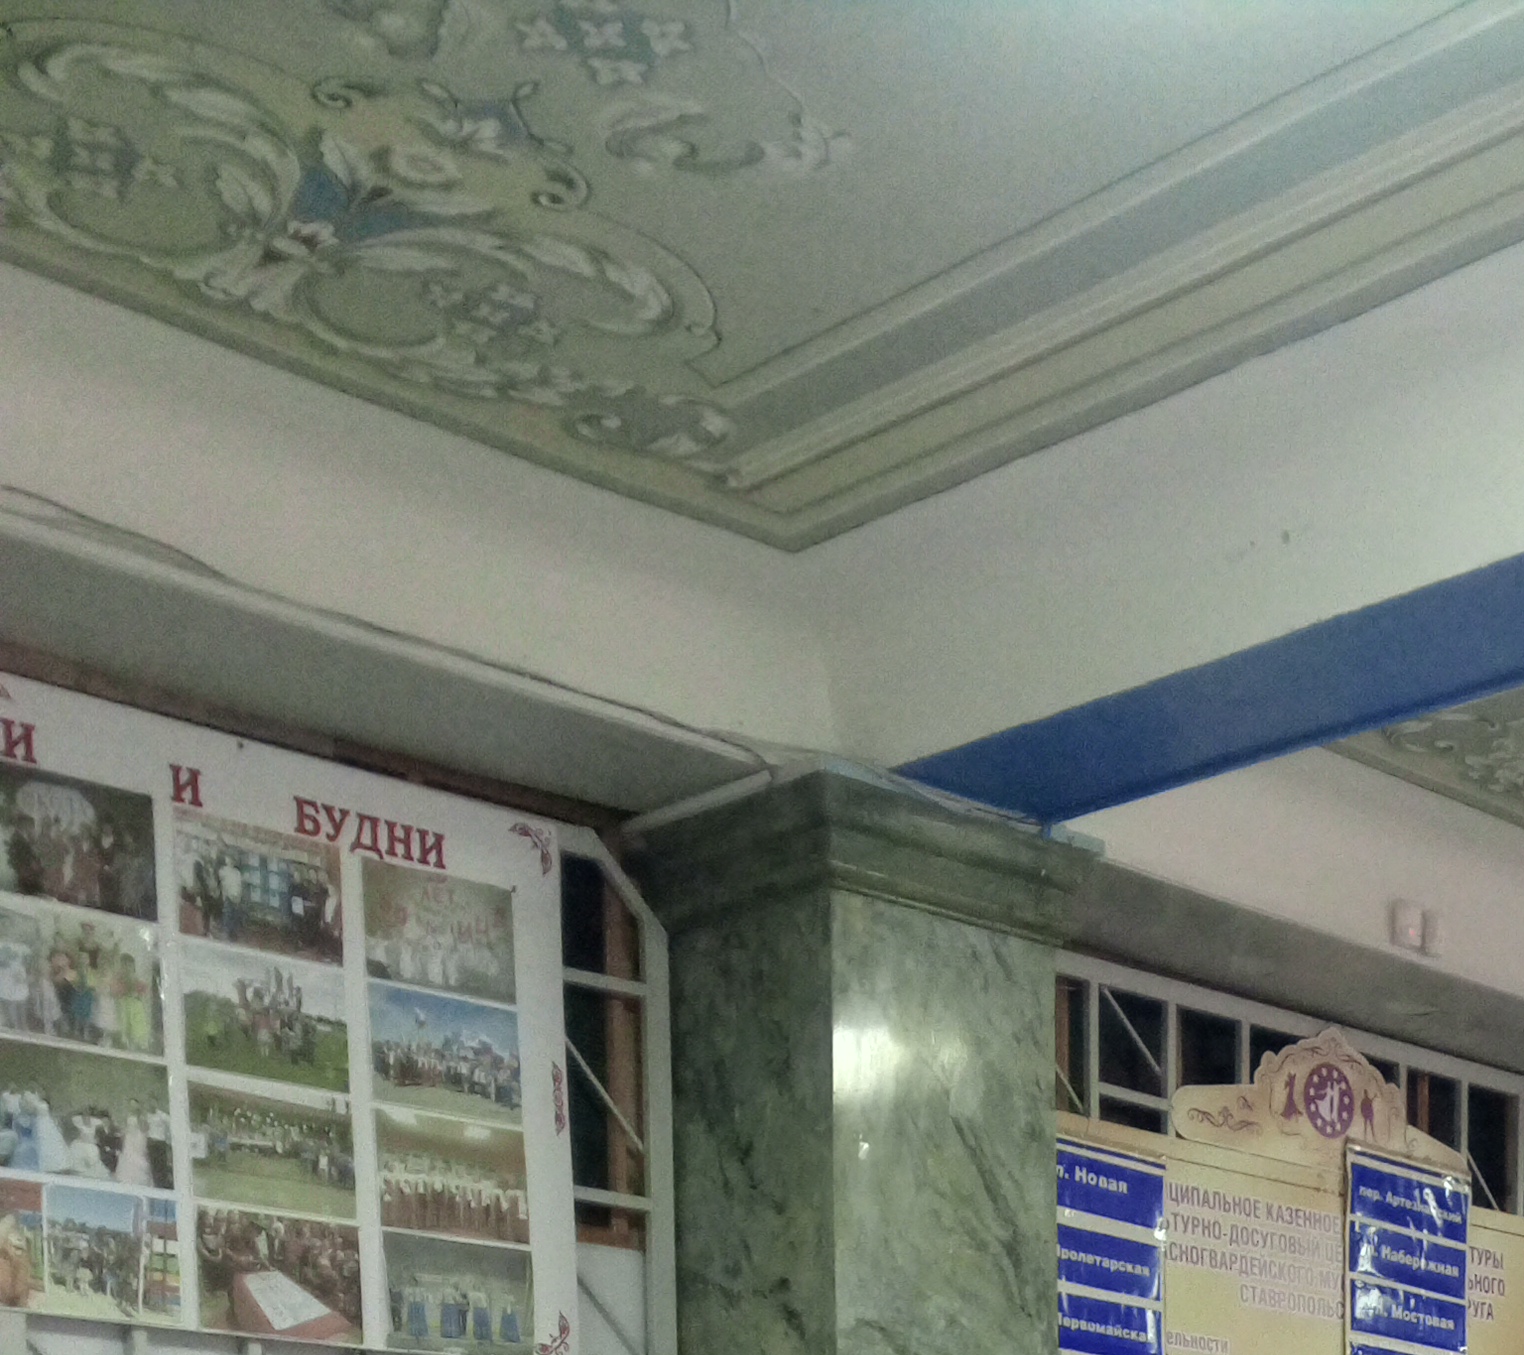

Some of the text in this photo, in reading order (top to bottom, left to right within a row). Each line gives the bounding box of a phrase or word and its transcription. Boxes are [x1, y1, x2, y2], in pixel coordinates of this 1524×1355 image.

[0, 719, 447, 869] И И БУДНИ
[1075, 1166, 1128, 1194] Новая
[1166, 1182, 1341, 1235] ЦИПАЛЬНОЕ КАЗЕННОЕ
[1386, 1192, 1463, 1224] Артезиаский
[1326, 1242, 1343, 1264] ЦЕ
[1382, 1246, 1459, 1278] Набержная
[1469, 1246, 1504, 1269] ТУРЫ
[1319, 1270, 1342, 1291] МУ
[1468, 1275, 1505, 1296] ЬНОГО
[1240, 1285, 1344, 1320] СТАВРОПОЛЬС
[1468, 1302, 1494, 1320] УГА
[1058, 1313, 1150, 1343] ервомайска
[1391, 1306, 1454, 1330] Мостовая
[1166, 1334, 1230, 1351] ельности
